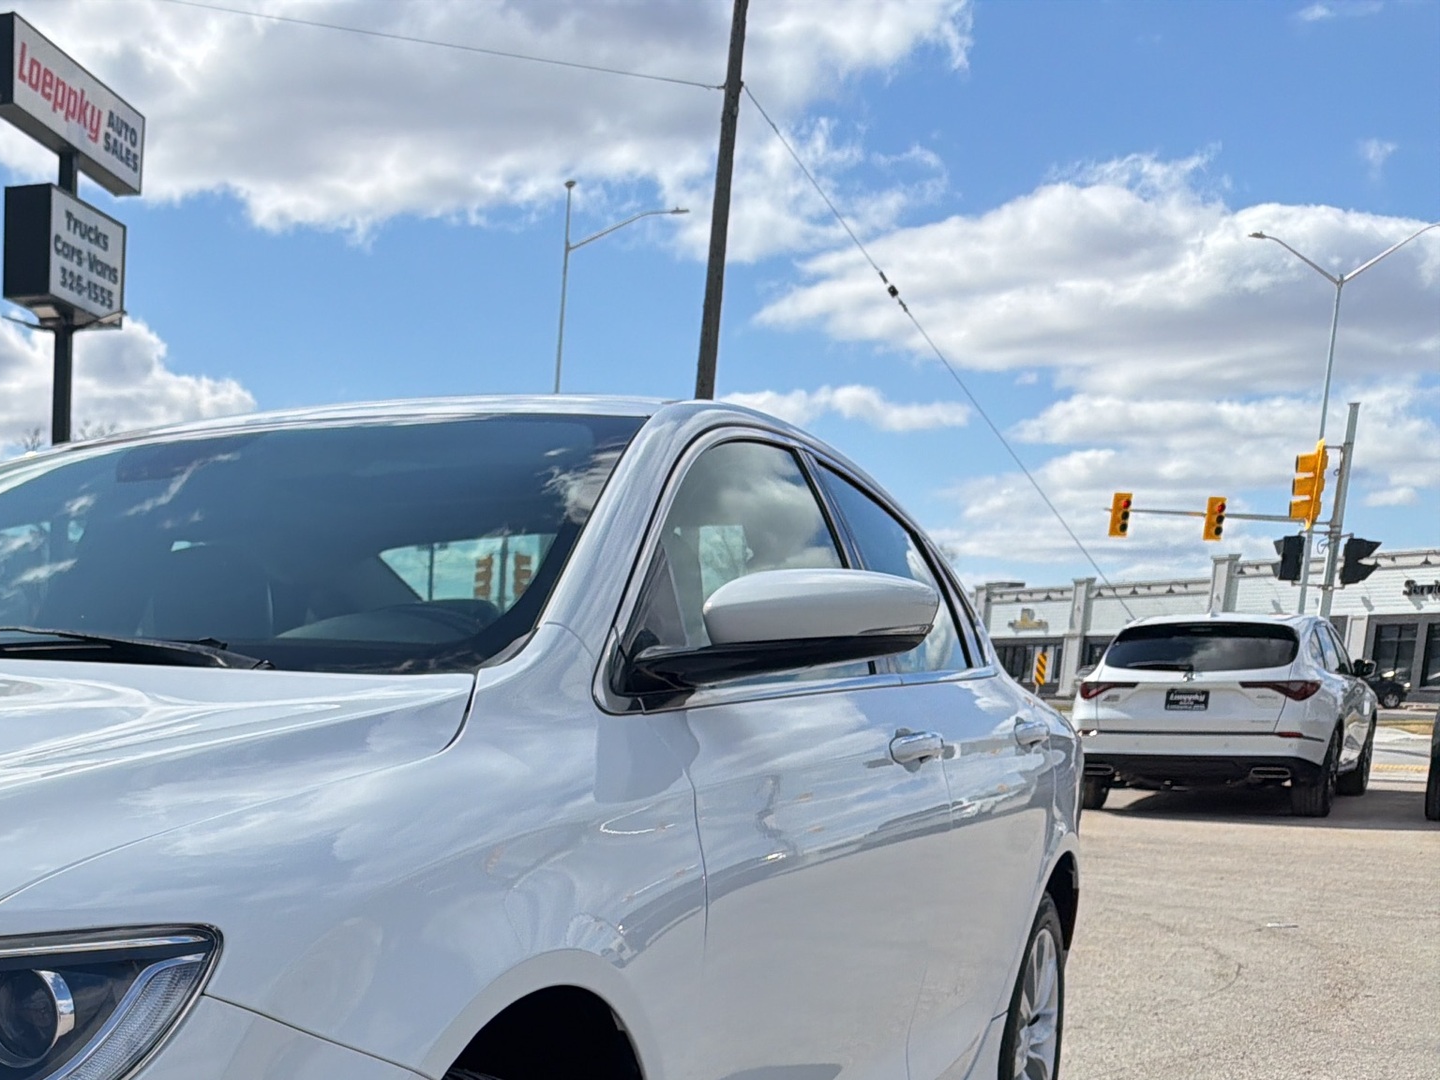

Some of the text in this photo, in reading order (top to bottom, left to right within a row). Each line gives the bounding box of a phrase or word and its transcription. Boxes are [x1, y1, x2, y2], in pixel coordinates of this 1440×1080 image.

[18, 41, 103, 145] Loeppky
[107, 109, 138, 148] AUTO
[103, 130, 140, 174] SALES
[65, 208, 109, 252] Trucks
